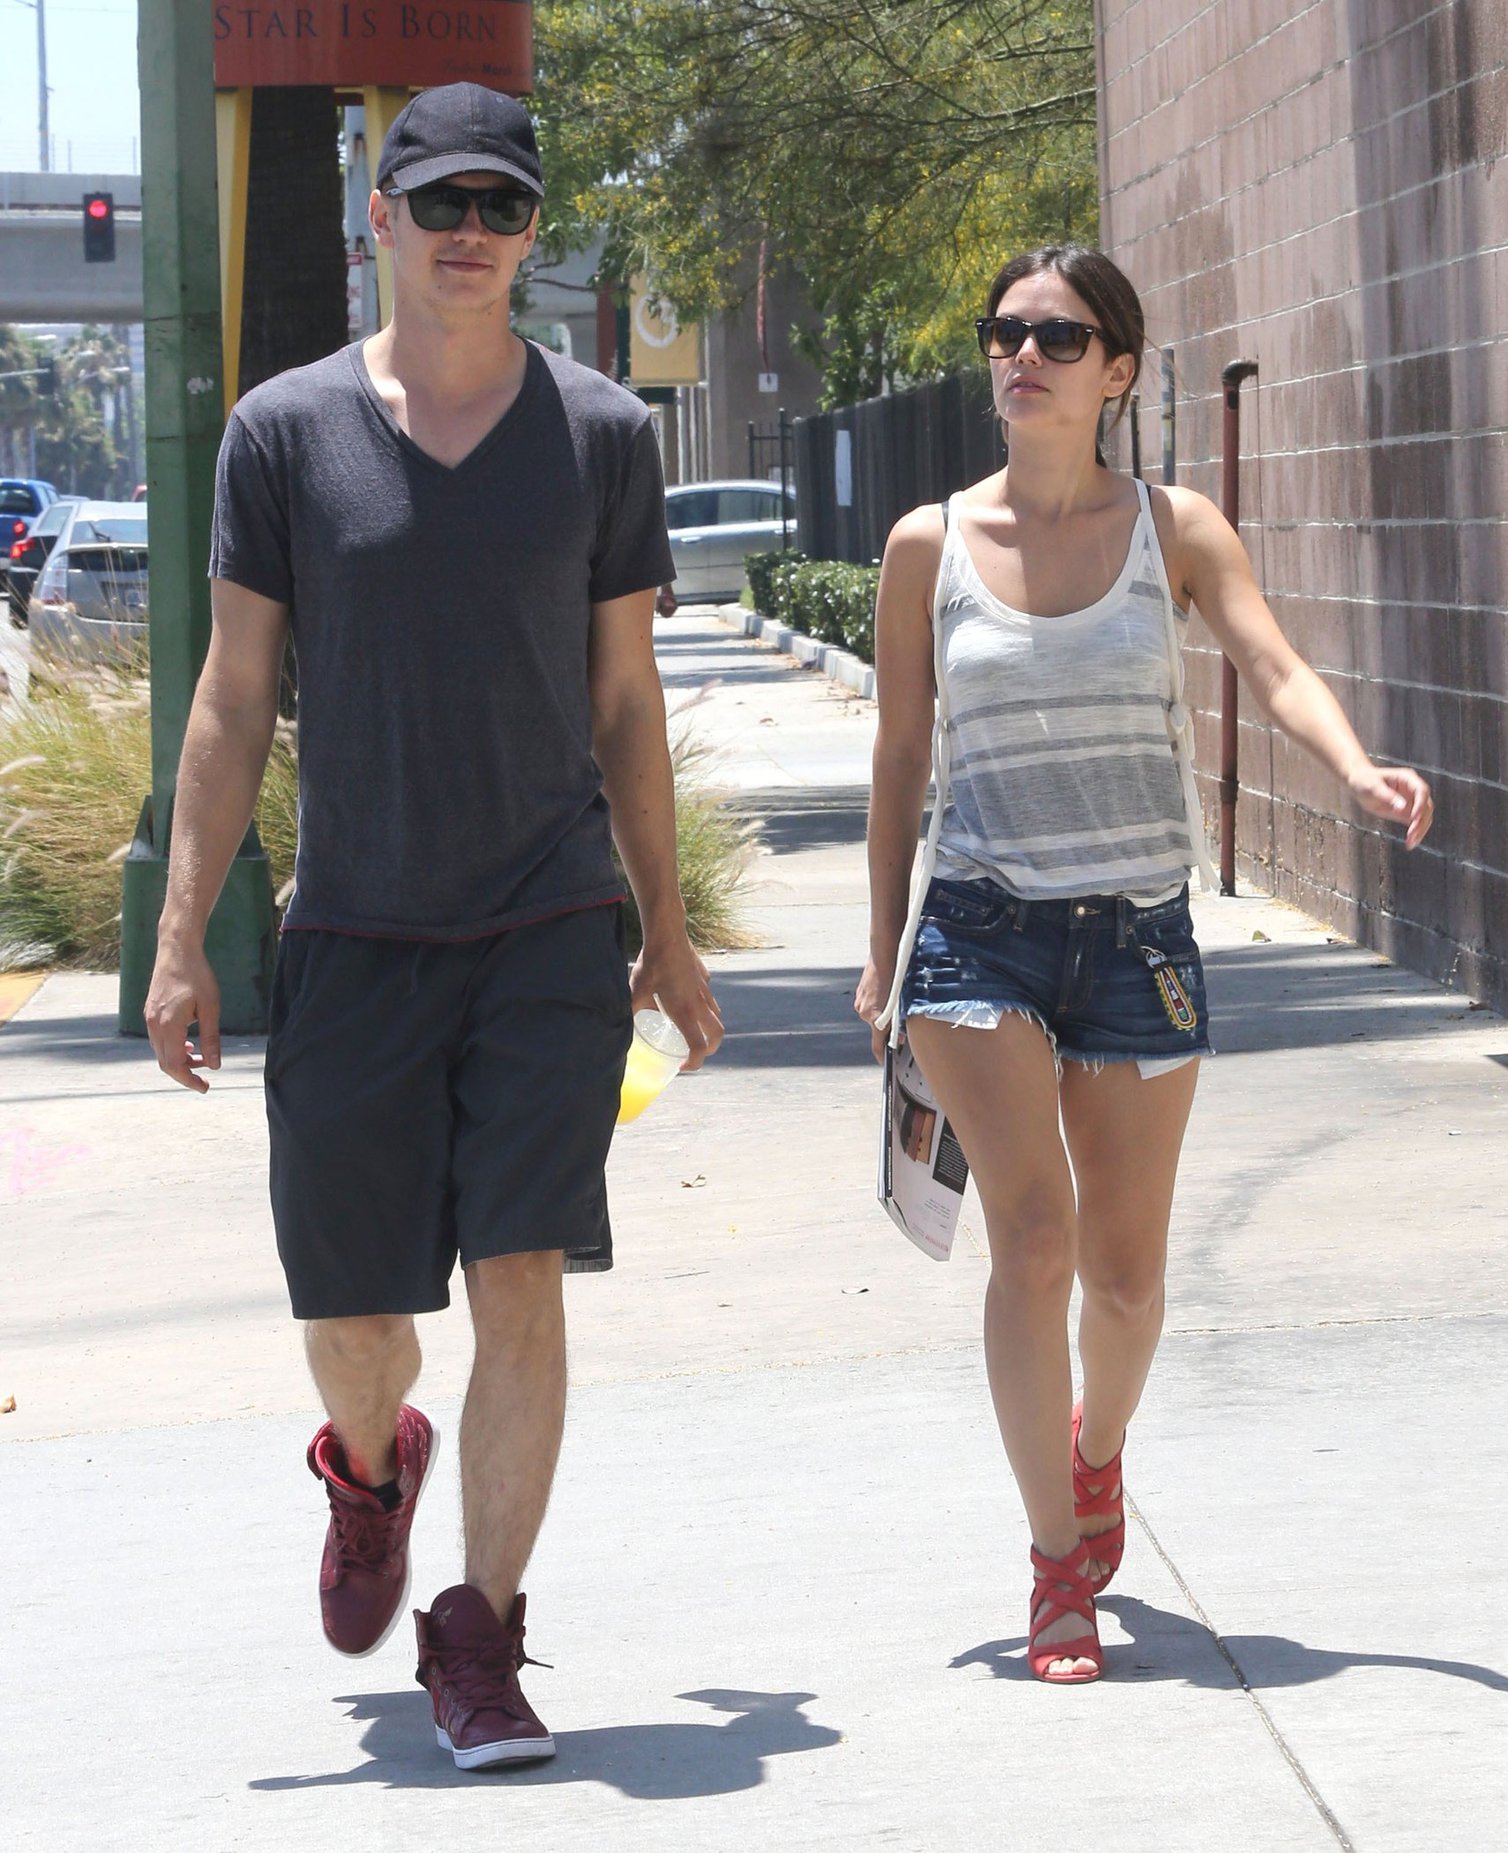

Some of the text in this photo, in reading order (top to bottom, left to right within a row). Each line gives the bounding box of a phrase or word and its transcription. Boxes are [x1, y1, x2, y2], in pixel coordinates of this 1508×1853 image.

[214, 3, 496, 41] STAR IS BORN
